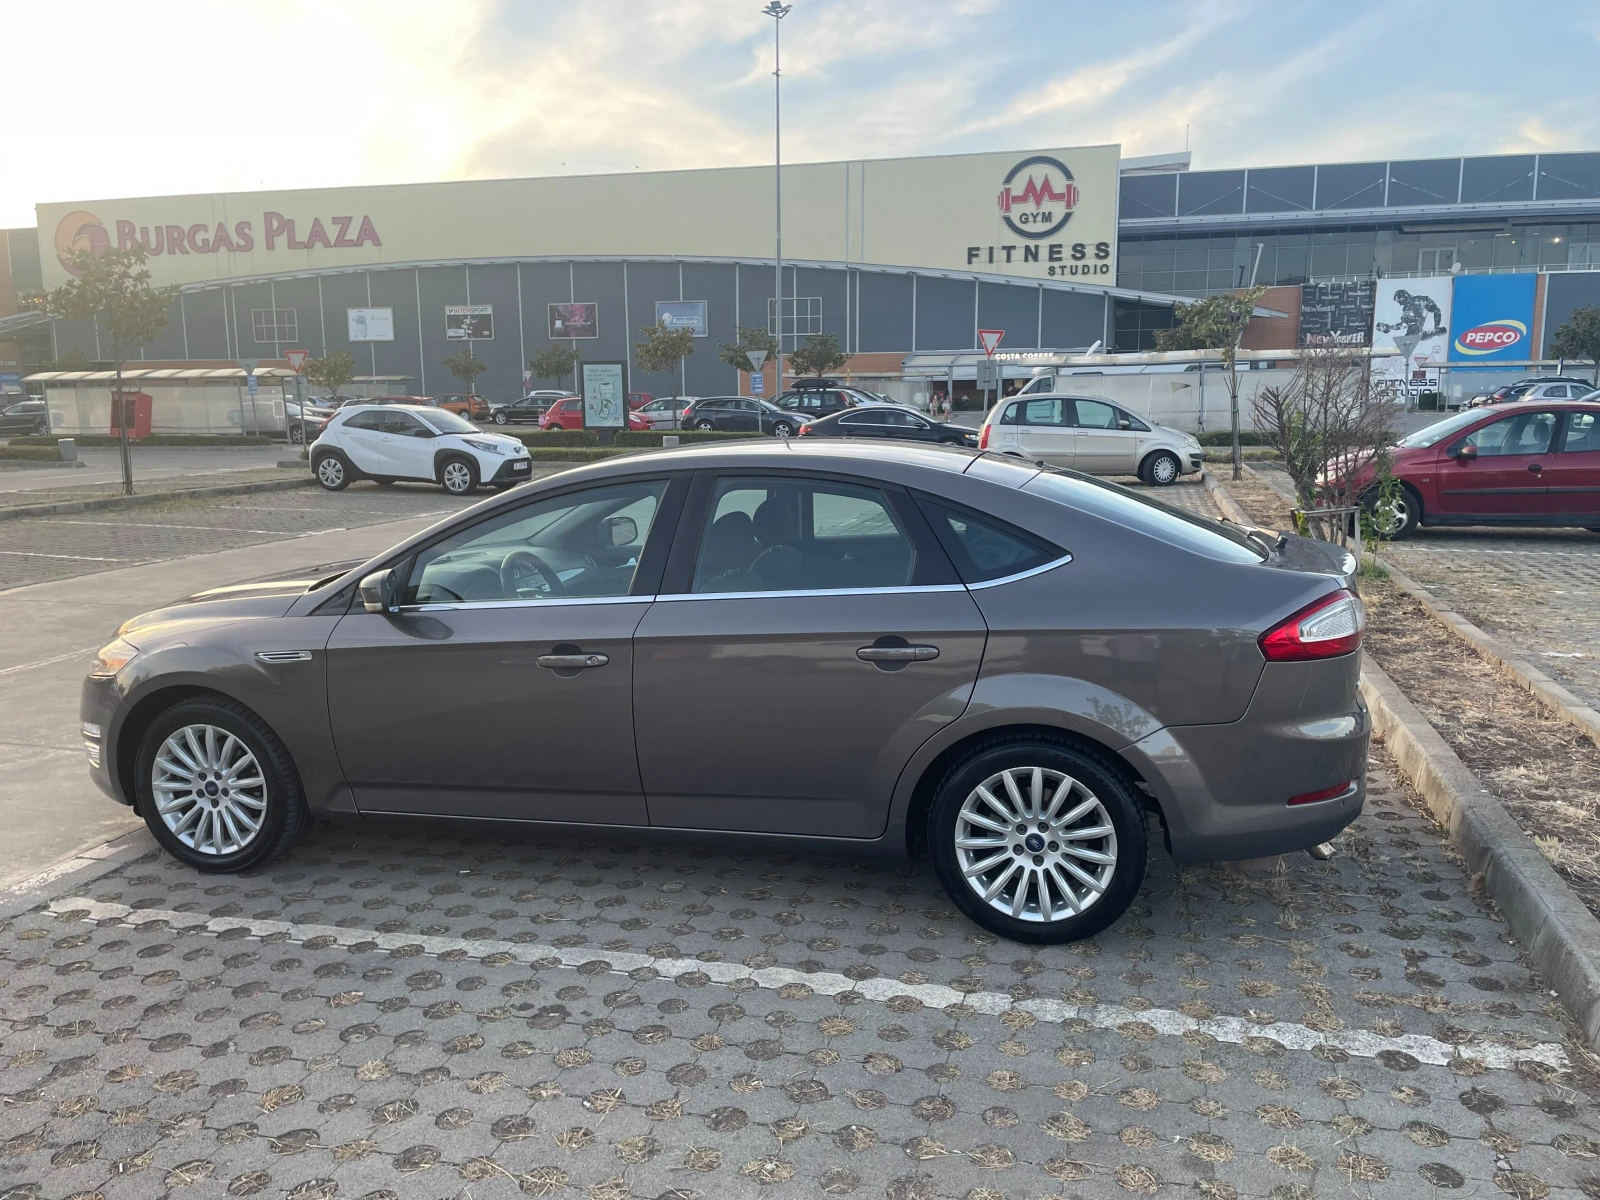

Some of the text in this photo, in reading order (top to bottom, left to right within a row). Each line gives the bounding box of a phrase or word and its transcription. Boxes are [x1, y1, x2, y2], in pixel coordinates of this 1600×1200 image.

[1019, 211, 1053, 224] GYM
[116, 211, 382, 256] BURGAS PLAZA
[967, 242, 1110, 265] FITNESS
[1047, 263, 1110, 277] STUDIO
[1465, 331, 1515, 344] PEPCO
